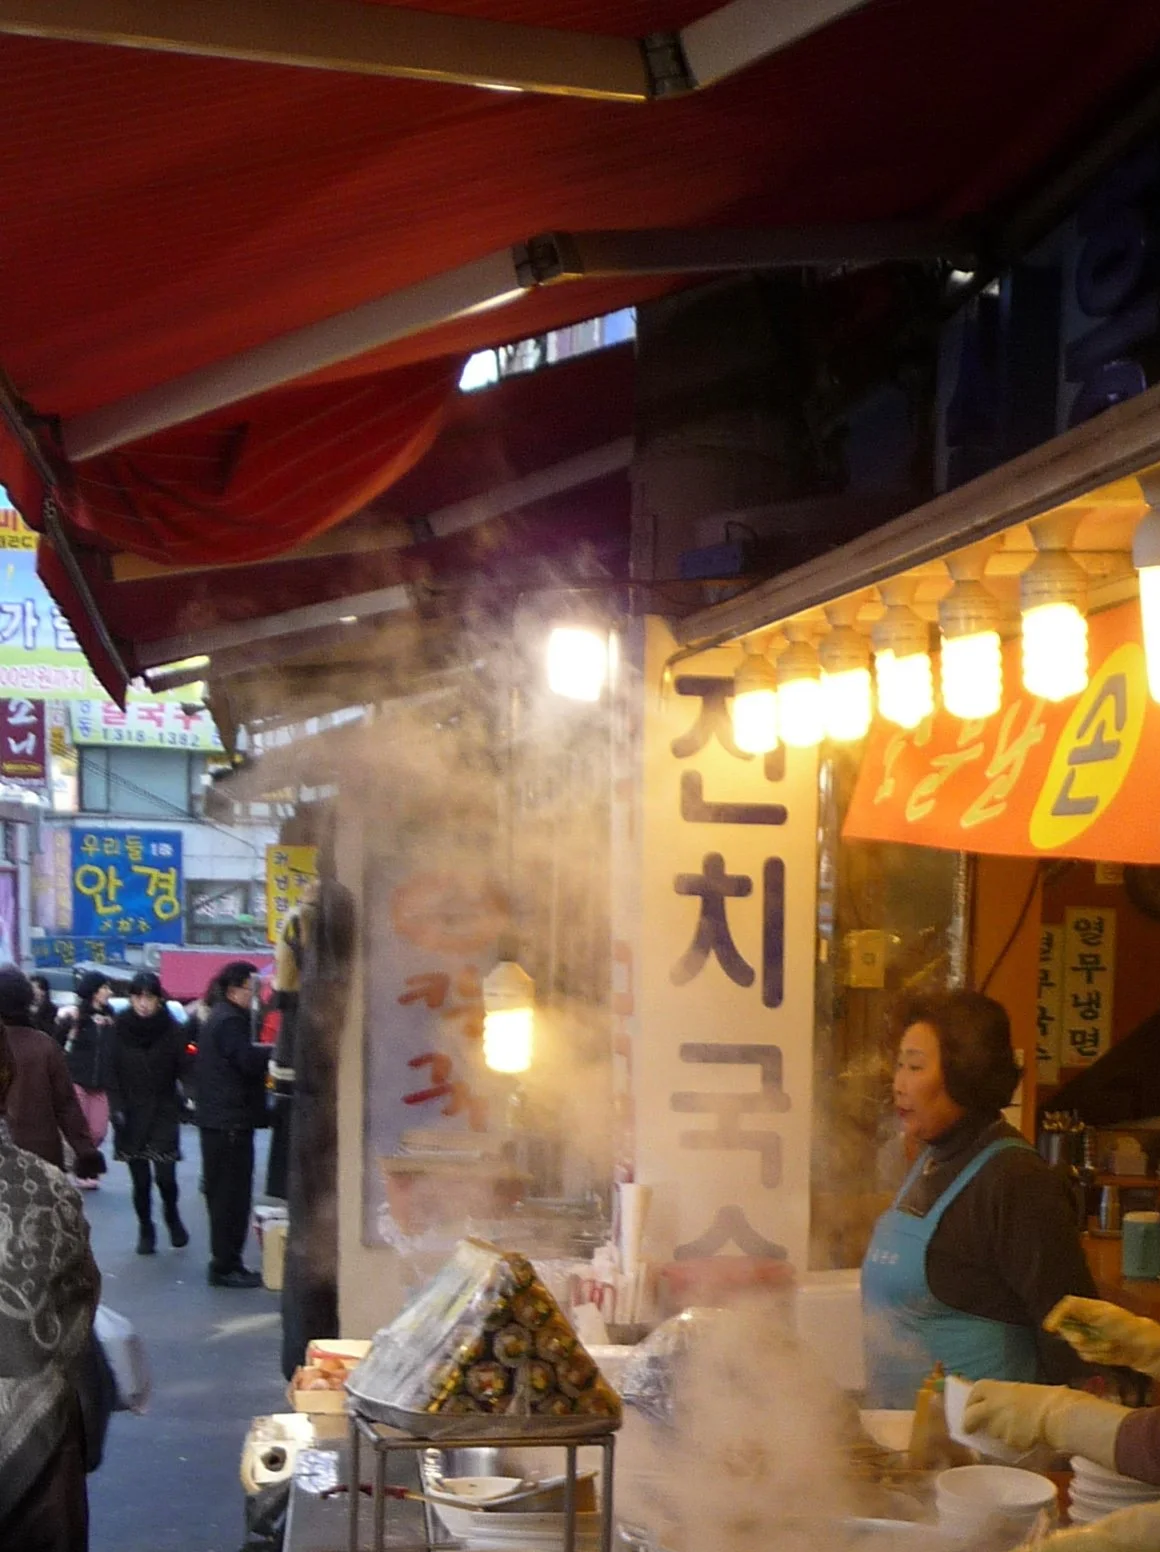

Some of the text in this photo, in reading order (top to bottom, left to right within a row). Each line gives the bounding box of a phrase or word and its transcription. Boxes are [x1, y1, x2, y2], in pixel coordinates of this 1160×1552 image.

[80, 834, 145, 862] 우리들
[74, 863, 181, 921] 안경
[1067, 914, 1107, 1058] 열무냉면
